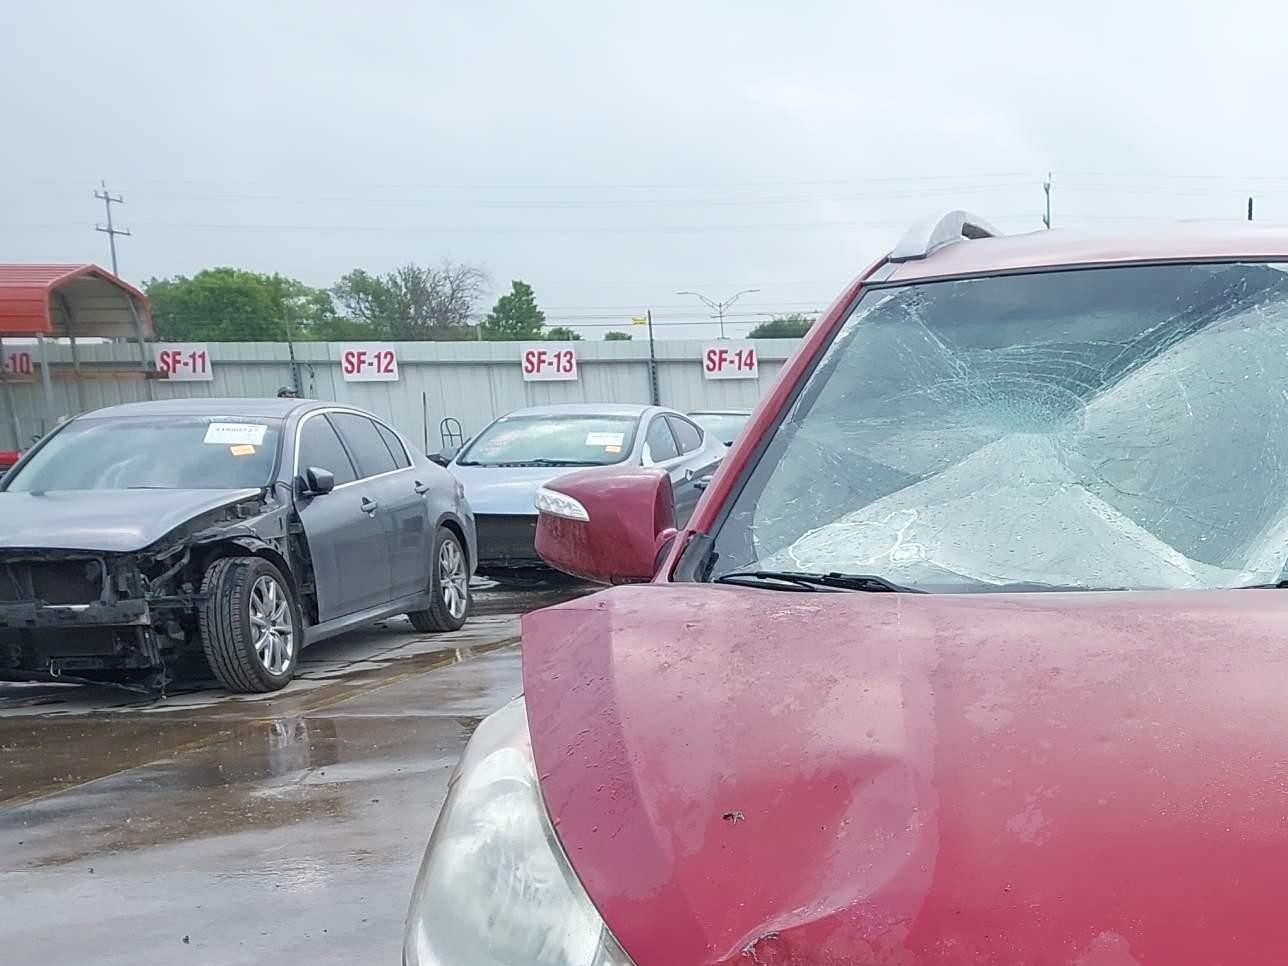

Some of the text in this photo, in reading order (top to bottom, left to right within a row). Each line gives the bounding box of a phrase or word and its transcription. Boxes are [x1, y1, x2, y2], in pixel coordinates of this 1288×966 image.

[159, 350, 207, 374] SF-11
[344, 350, 395, 374] SF-12
[524, 350, 575, 374] SF-13
[705, 349, 756, 372] SF-14
